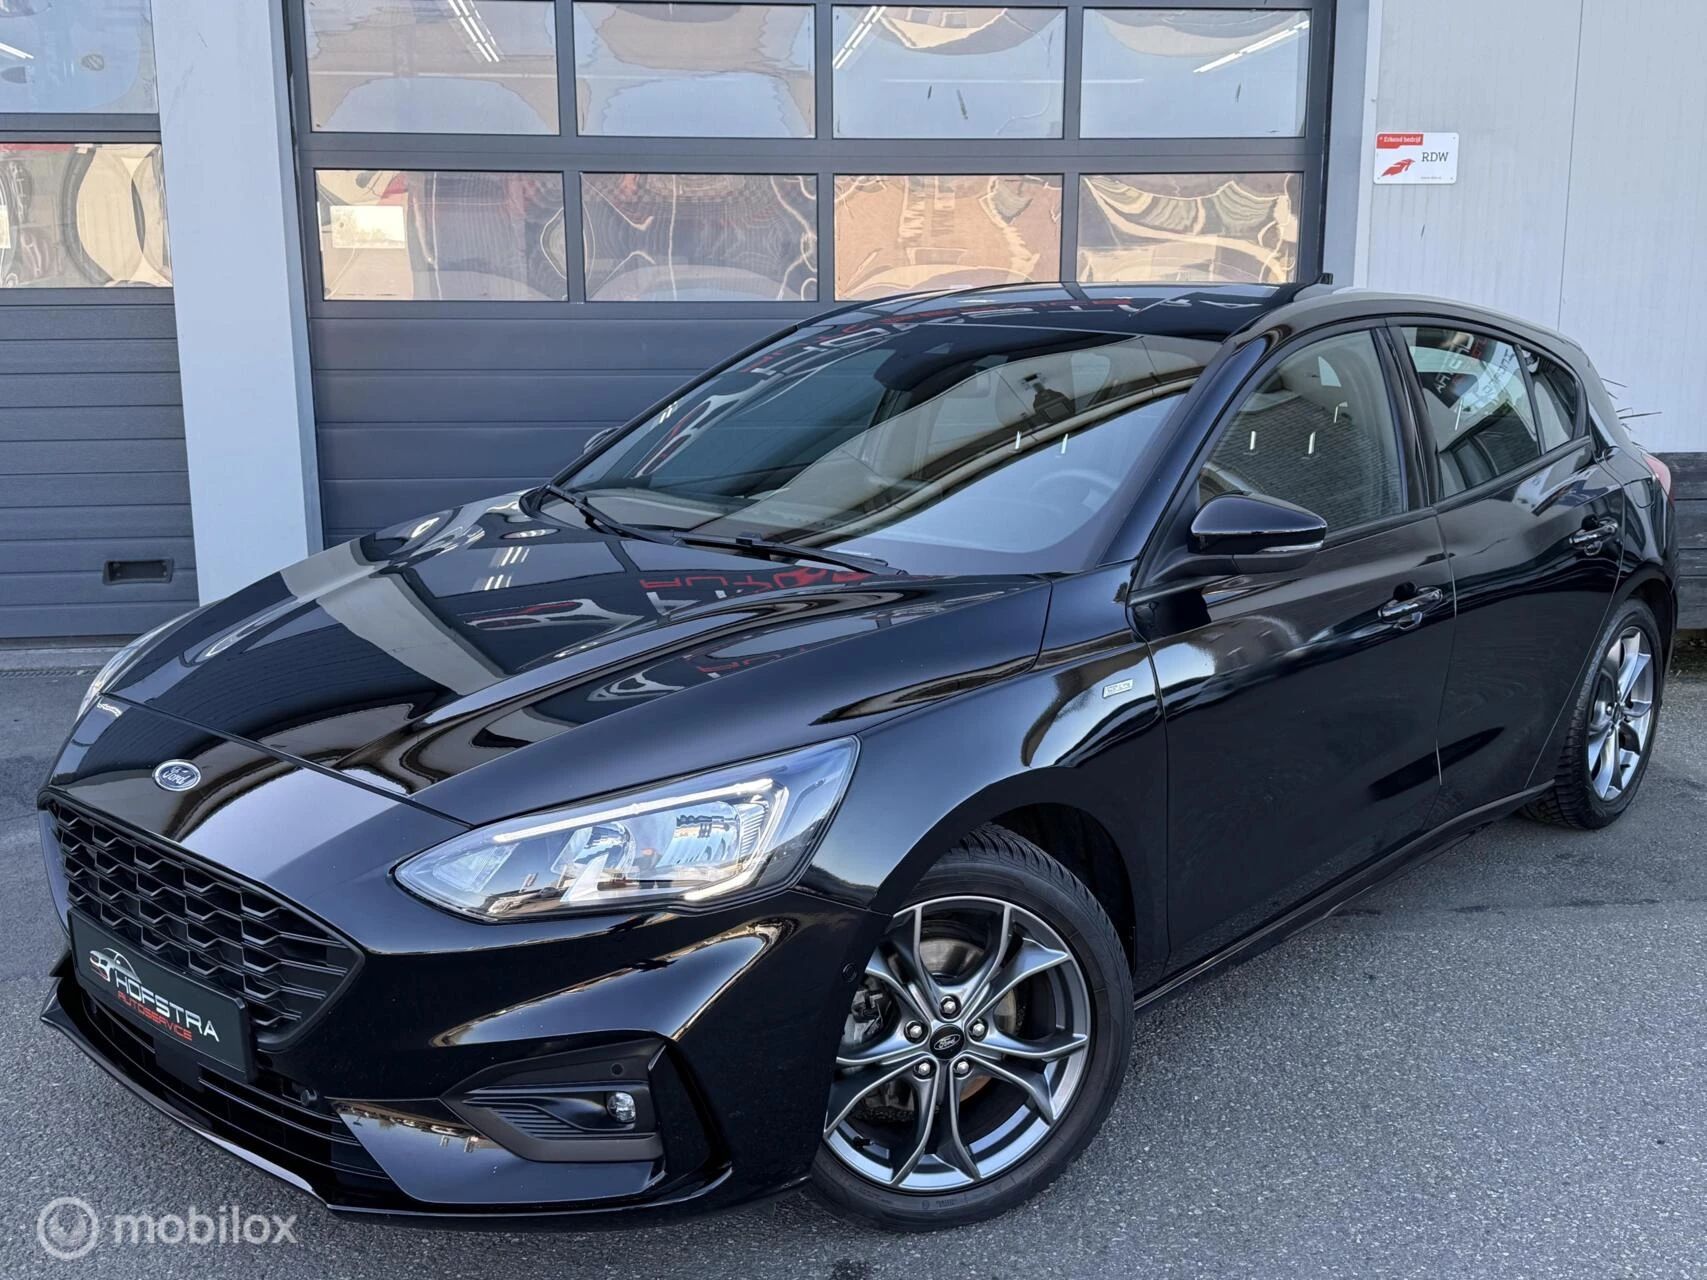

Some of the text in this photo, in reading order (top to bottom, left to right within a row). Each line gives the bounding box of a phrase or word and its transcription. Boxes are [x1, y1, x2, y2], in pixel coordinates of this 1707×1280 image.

[1421, 152, 1449, 162] RDW
[114, 969, 220, 1042] HOFSTRA
[117, 990, 193, 1041] AUTOSERVICE
